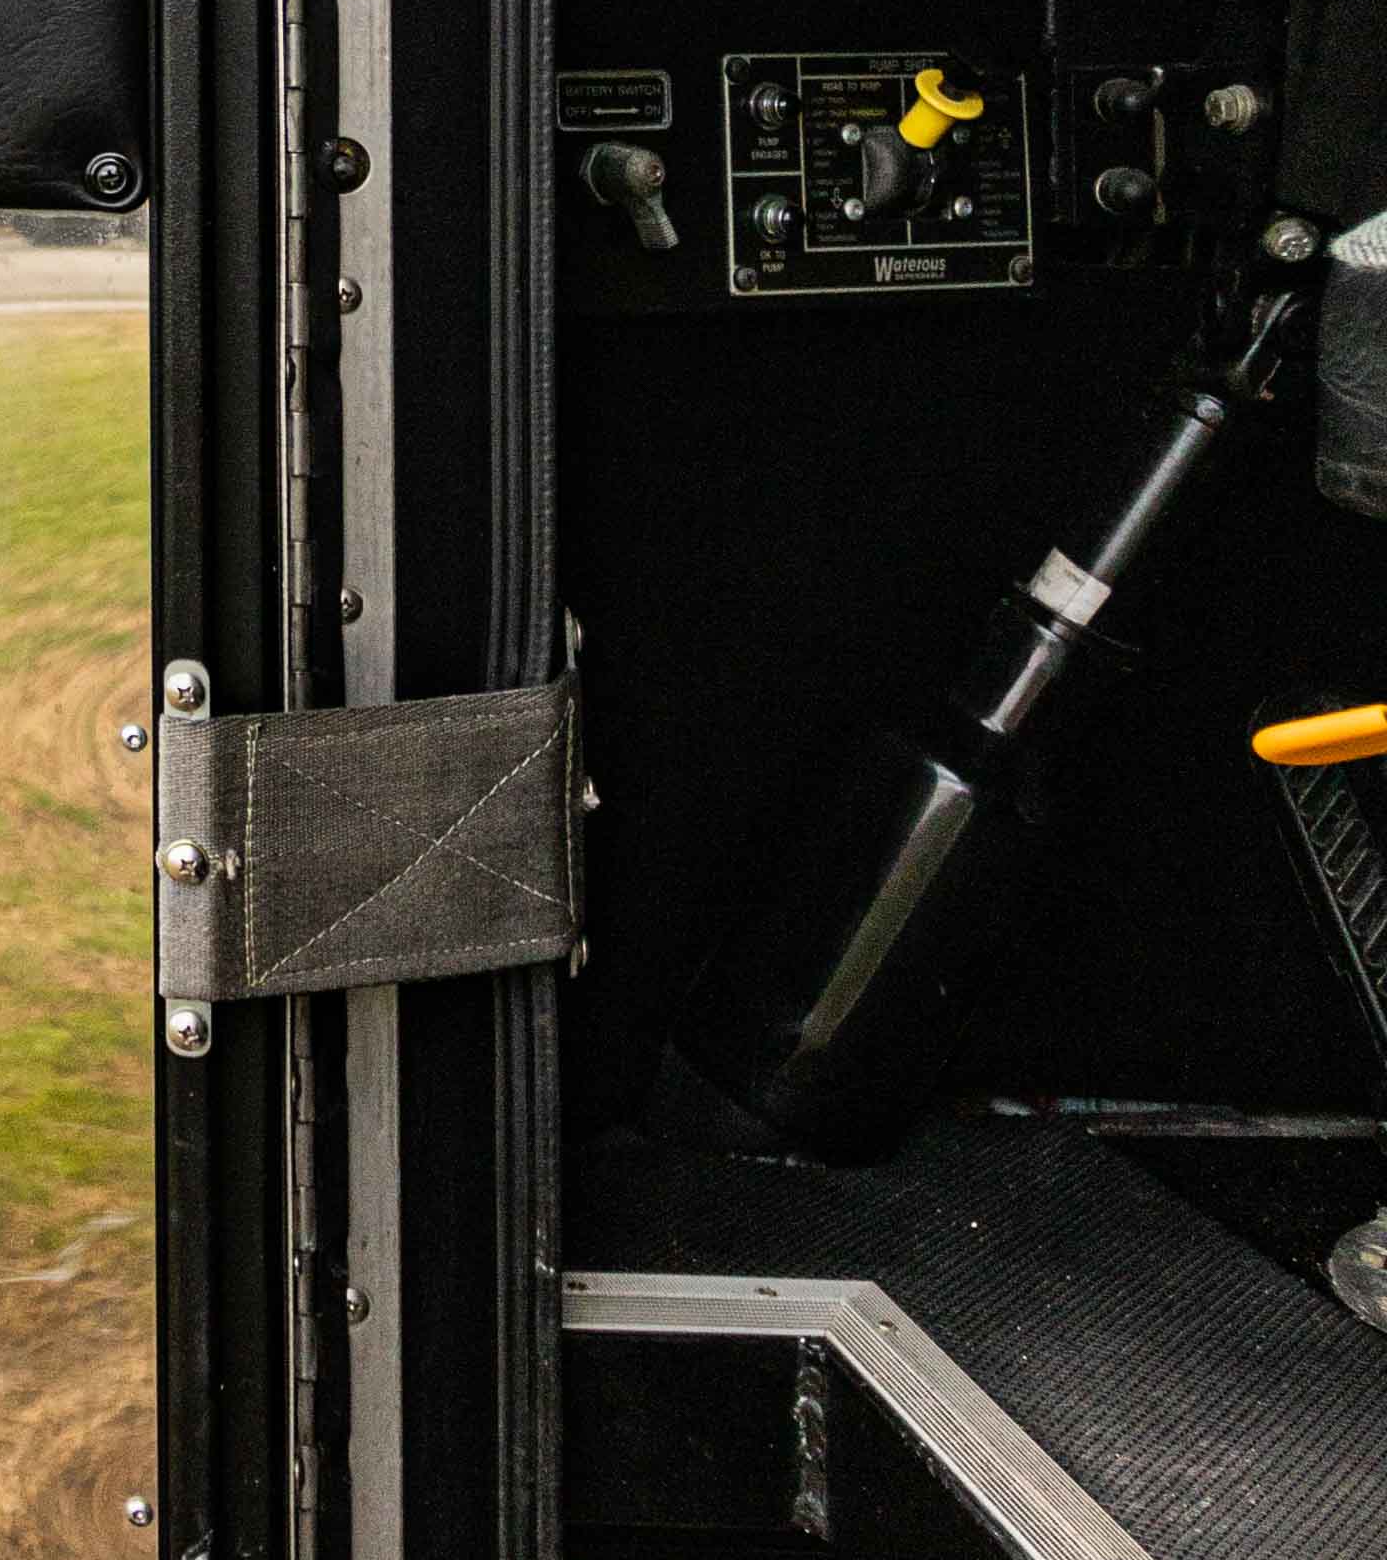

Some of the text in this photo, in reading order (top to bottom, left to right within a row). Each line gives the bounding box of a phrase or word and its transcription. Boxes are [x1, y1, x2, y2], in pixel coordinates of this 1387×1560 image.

[564, 83, 662, 98] BATTERY SWITCH
[873, 255, 947, 282] Waterous
